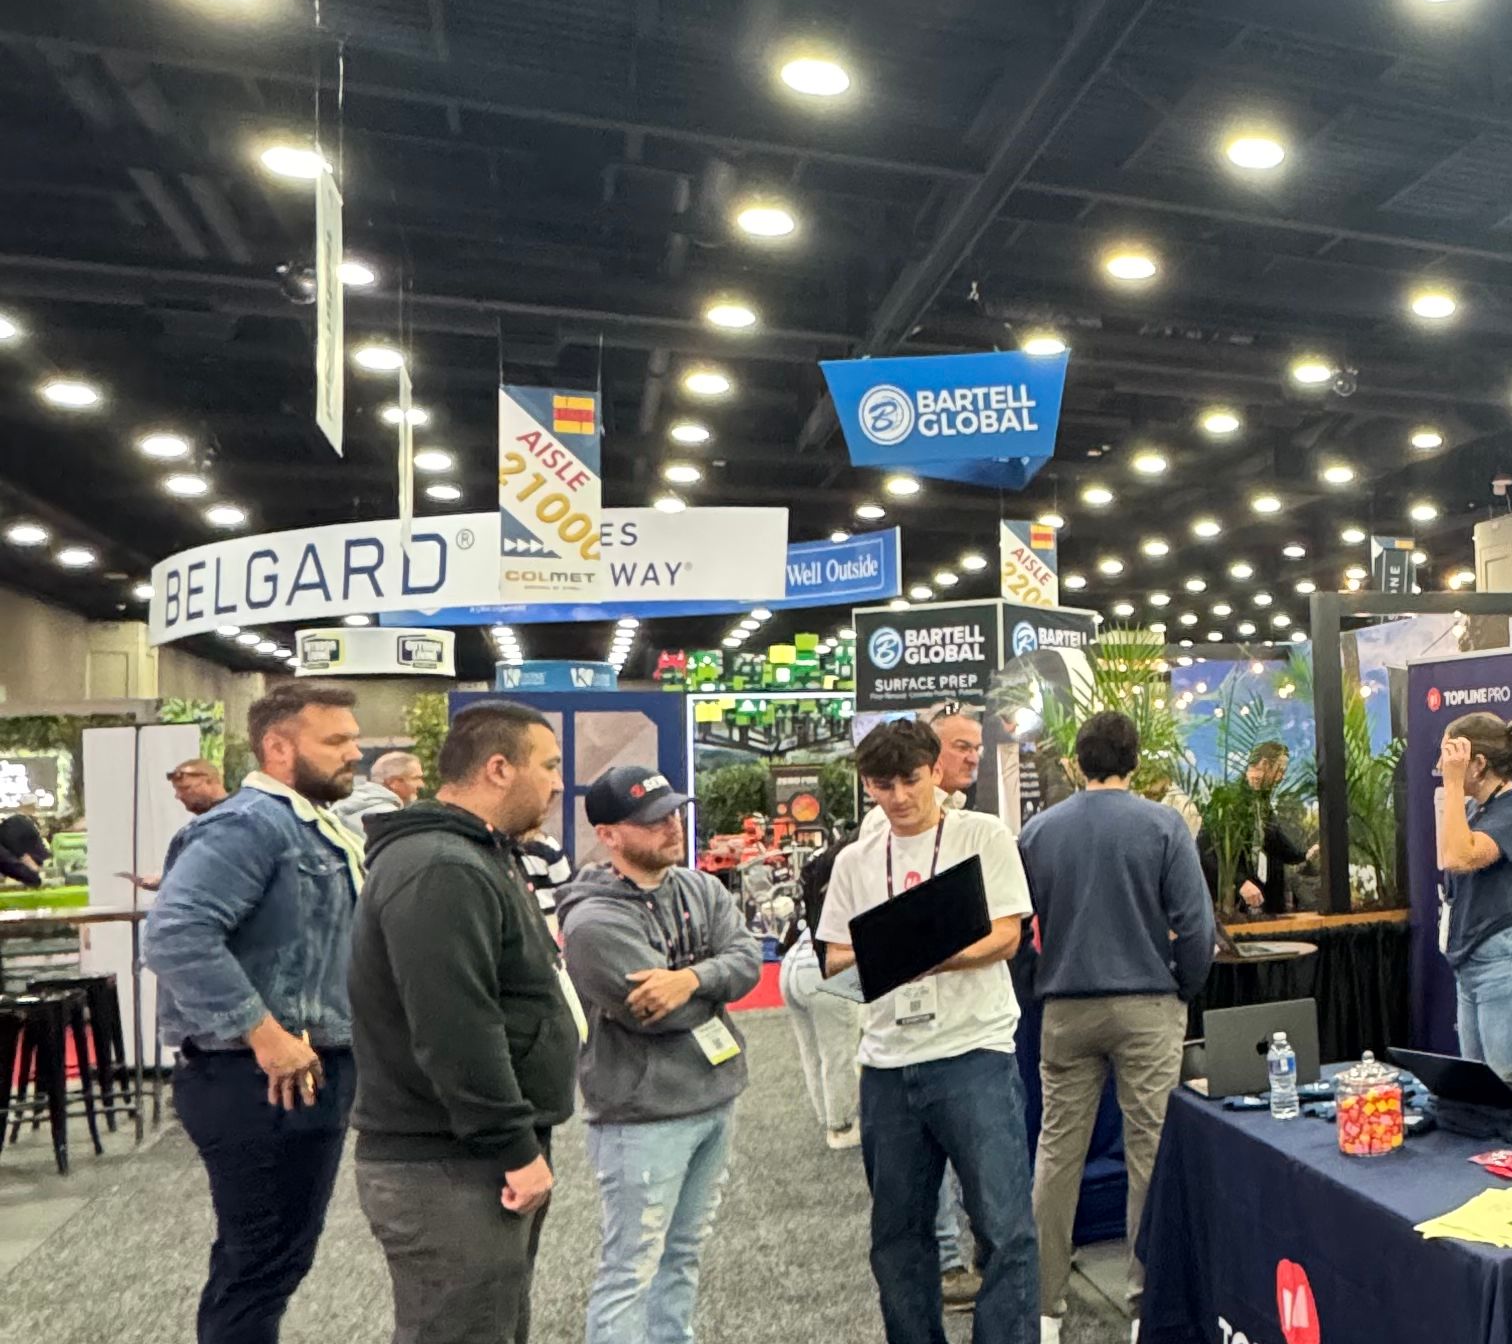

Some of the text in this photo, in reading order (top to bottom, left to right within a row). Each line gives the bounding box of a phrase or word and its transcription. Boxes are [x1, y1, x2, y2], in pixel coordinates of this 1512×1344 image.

[916, 383, 1036, 414] BARTELL
[917, 408, 1039, 437] GLOBAL
[516, 430, 591, 493] AISLE
[505, 570, 596, 583] COLMET
[787, 554, 878, 587] Well Outside
[1010, 546, 1052, 587] AISLE
[904, 624, 985, 647] BARTELL
[904, 645, 985, 666] GLOBAL
[874, 673, 978, 692] SURFACE PREP
